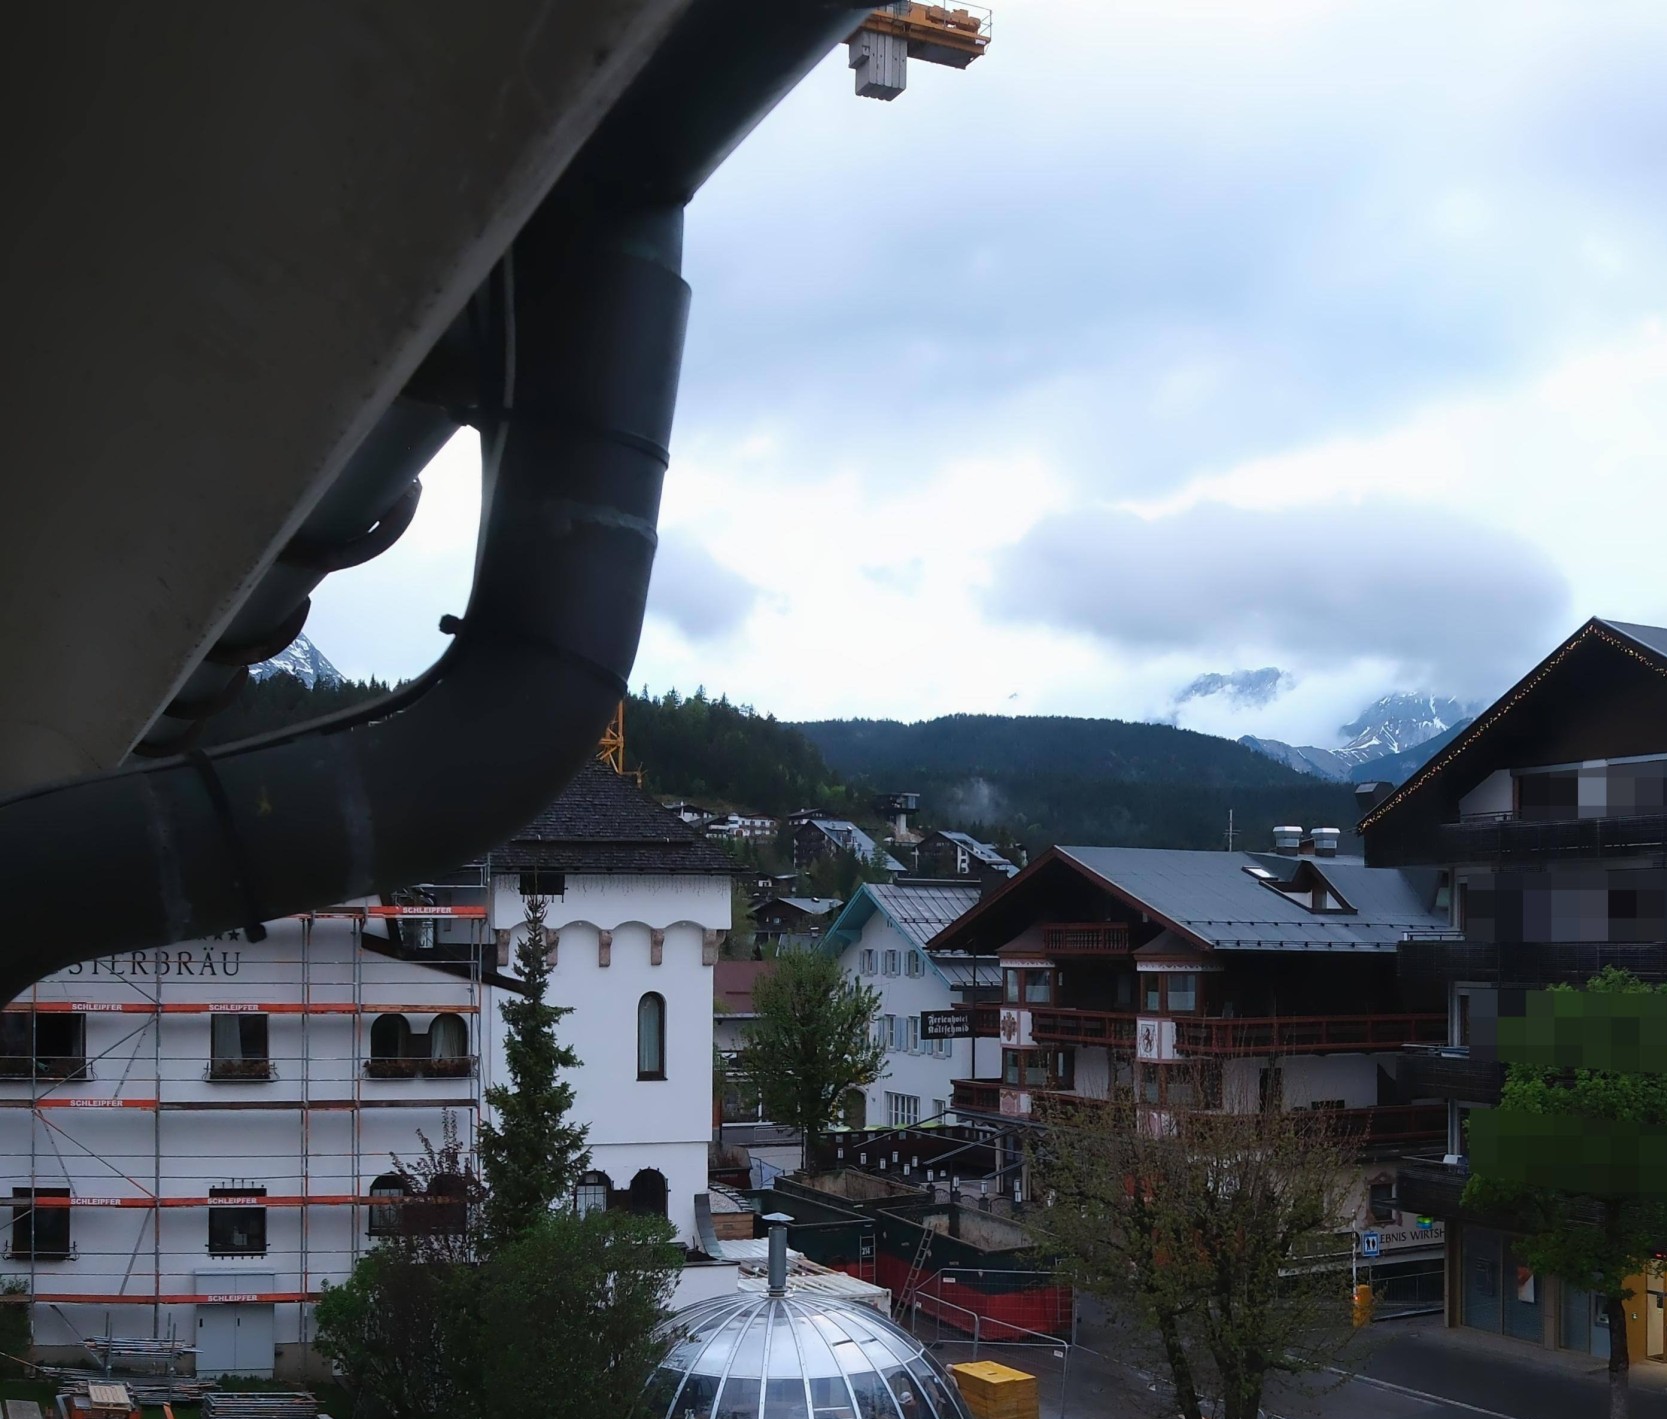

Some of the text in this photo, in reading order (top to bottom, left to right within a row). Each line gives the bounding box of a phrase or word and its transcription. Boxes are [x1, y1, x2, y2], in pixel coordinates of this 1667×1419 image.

[402, 906, 452, 914] SCHLEIPFER
[72, 1003, 122, 1011] SCHLEIPFER
[208, 1003, 259, 1011] SCHLEIPFER
[70, 1099, 123, 1108] SCHLEIPFER
[70, 1197, 121, 1206] SCHLEIPFER
[207, 1197, 257, 1205] SCHLEIPFER
[207, 1294, 258, 1302] SCHLEIPFER
